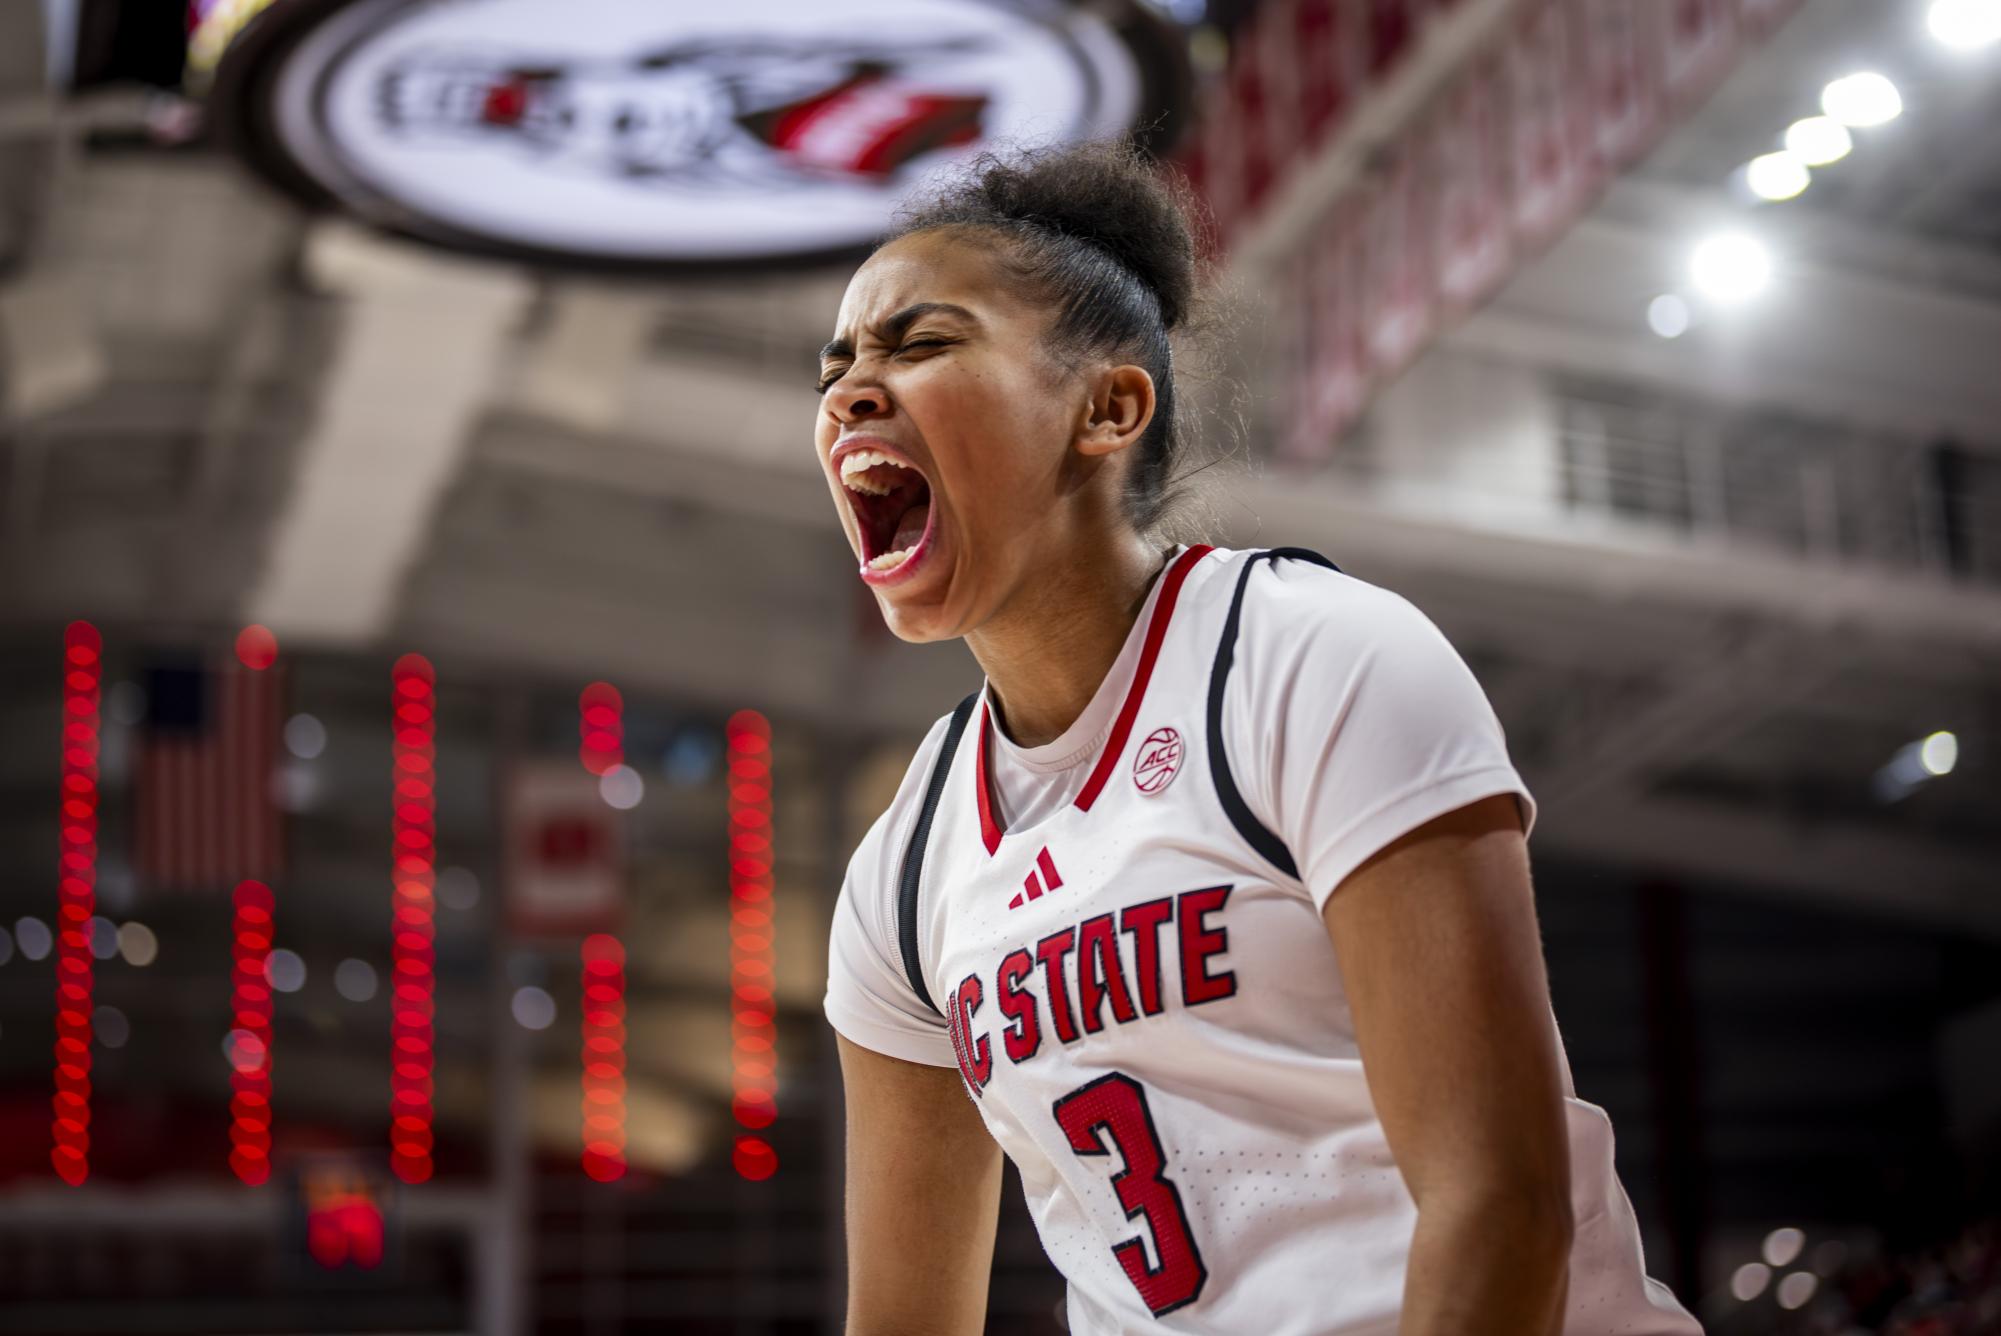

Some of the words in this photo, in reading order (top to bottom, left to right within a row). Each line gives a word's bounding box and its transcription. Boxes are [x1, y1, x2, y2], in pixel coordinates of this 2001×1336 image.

[1140, 741, 1180, 769] ACC
[996, 884, 1237, 1065] STATE
[1052, 1071, 1208, 1318] 3
